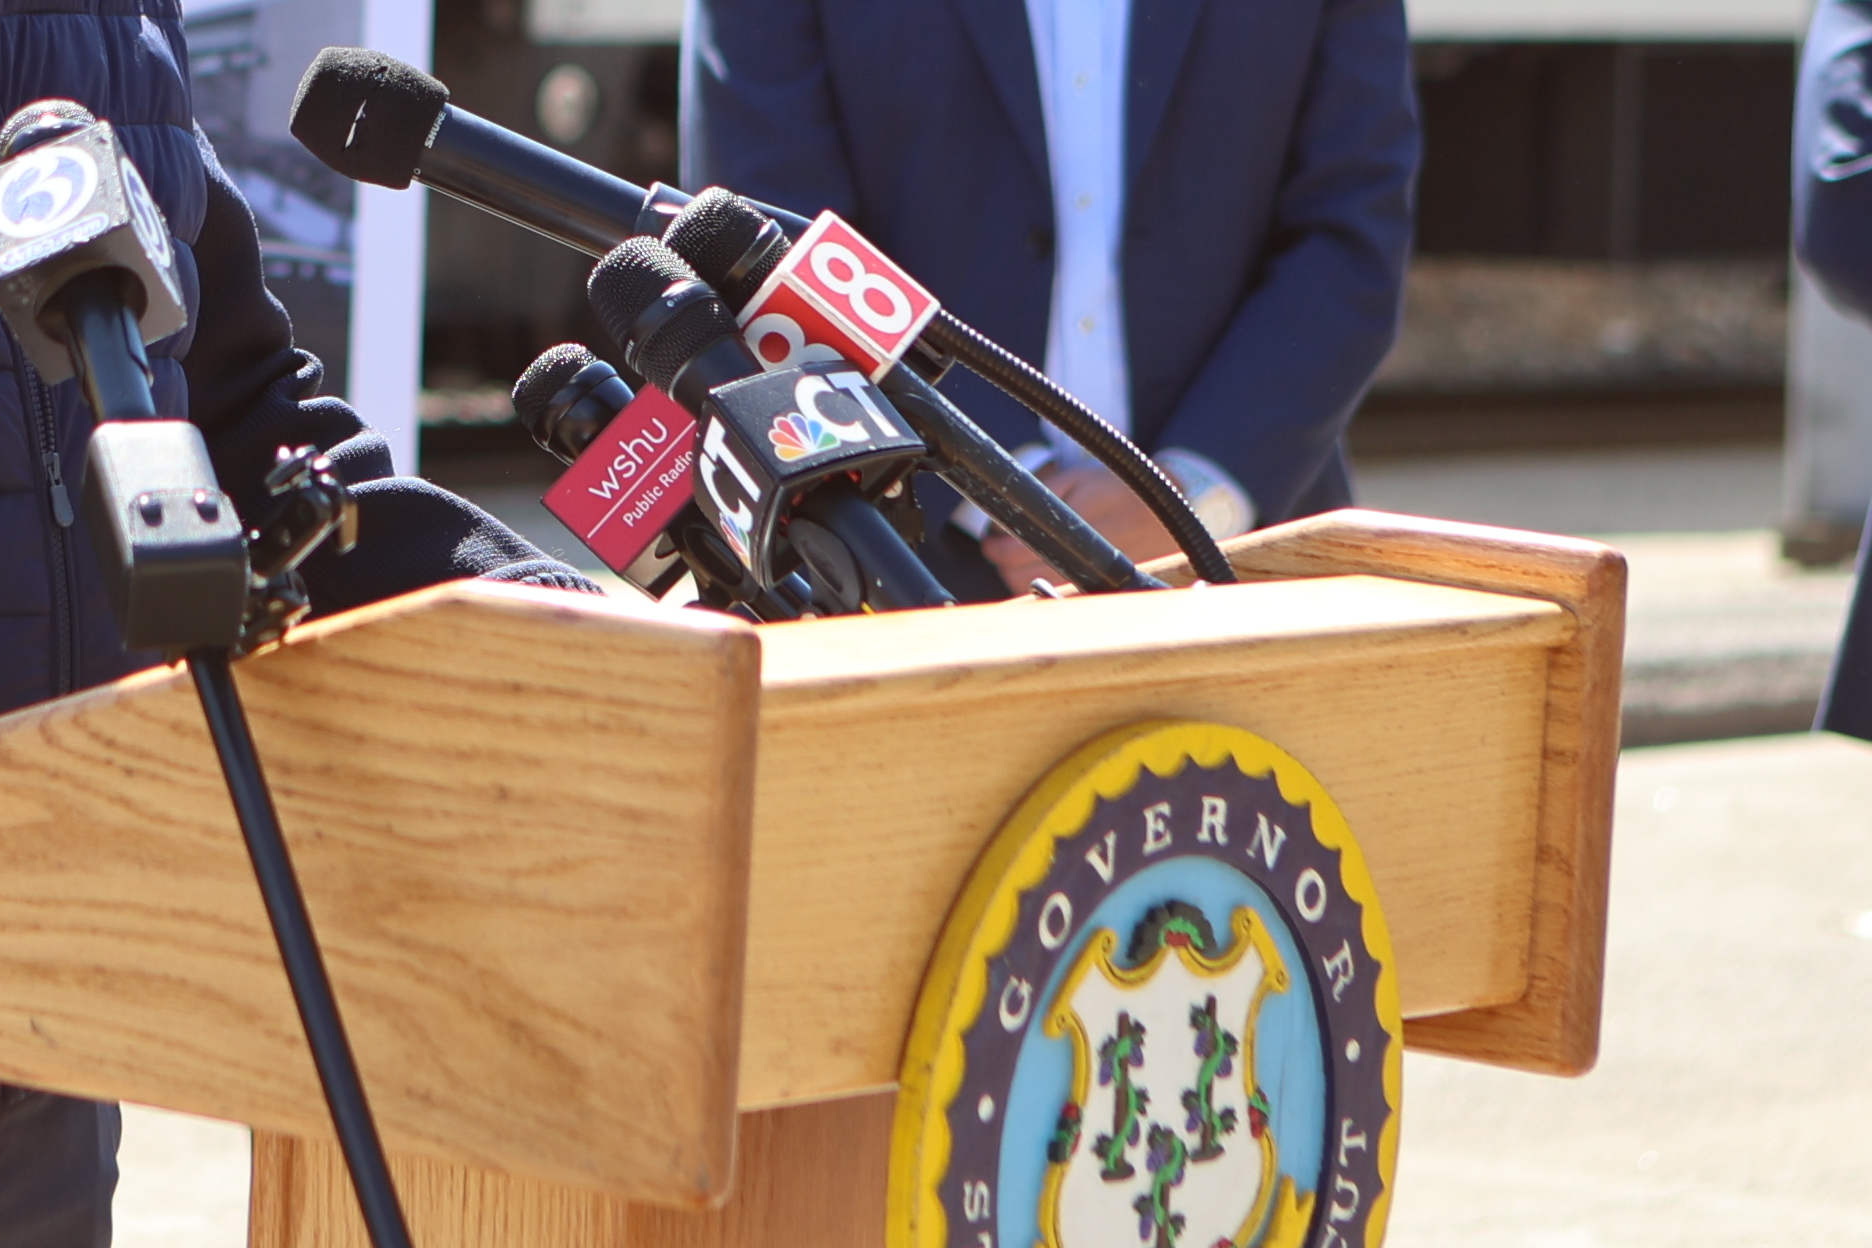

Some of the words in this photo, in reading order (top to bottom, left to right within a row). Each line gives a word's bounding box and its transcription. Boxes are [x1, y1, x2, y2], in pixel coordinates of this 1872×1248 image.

[424, 111, 446, 149] SHURE
[810, 241, 913, 334] 8
[794, 370, 900, 442] CT
[588, 417, 669, 500] wshu
[622, 484, 665, 527] Public
[658, 450, 694, 489] Radio
[699, 415, 762, 532] CT
[996, 795, 1359, 1033] GOVERNOR
